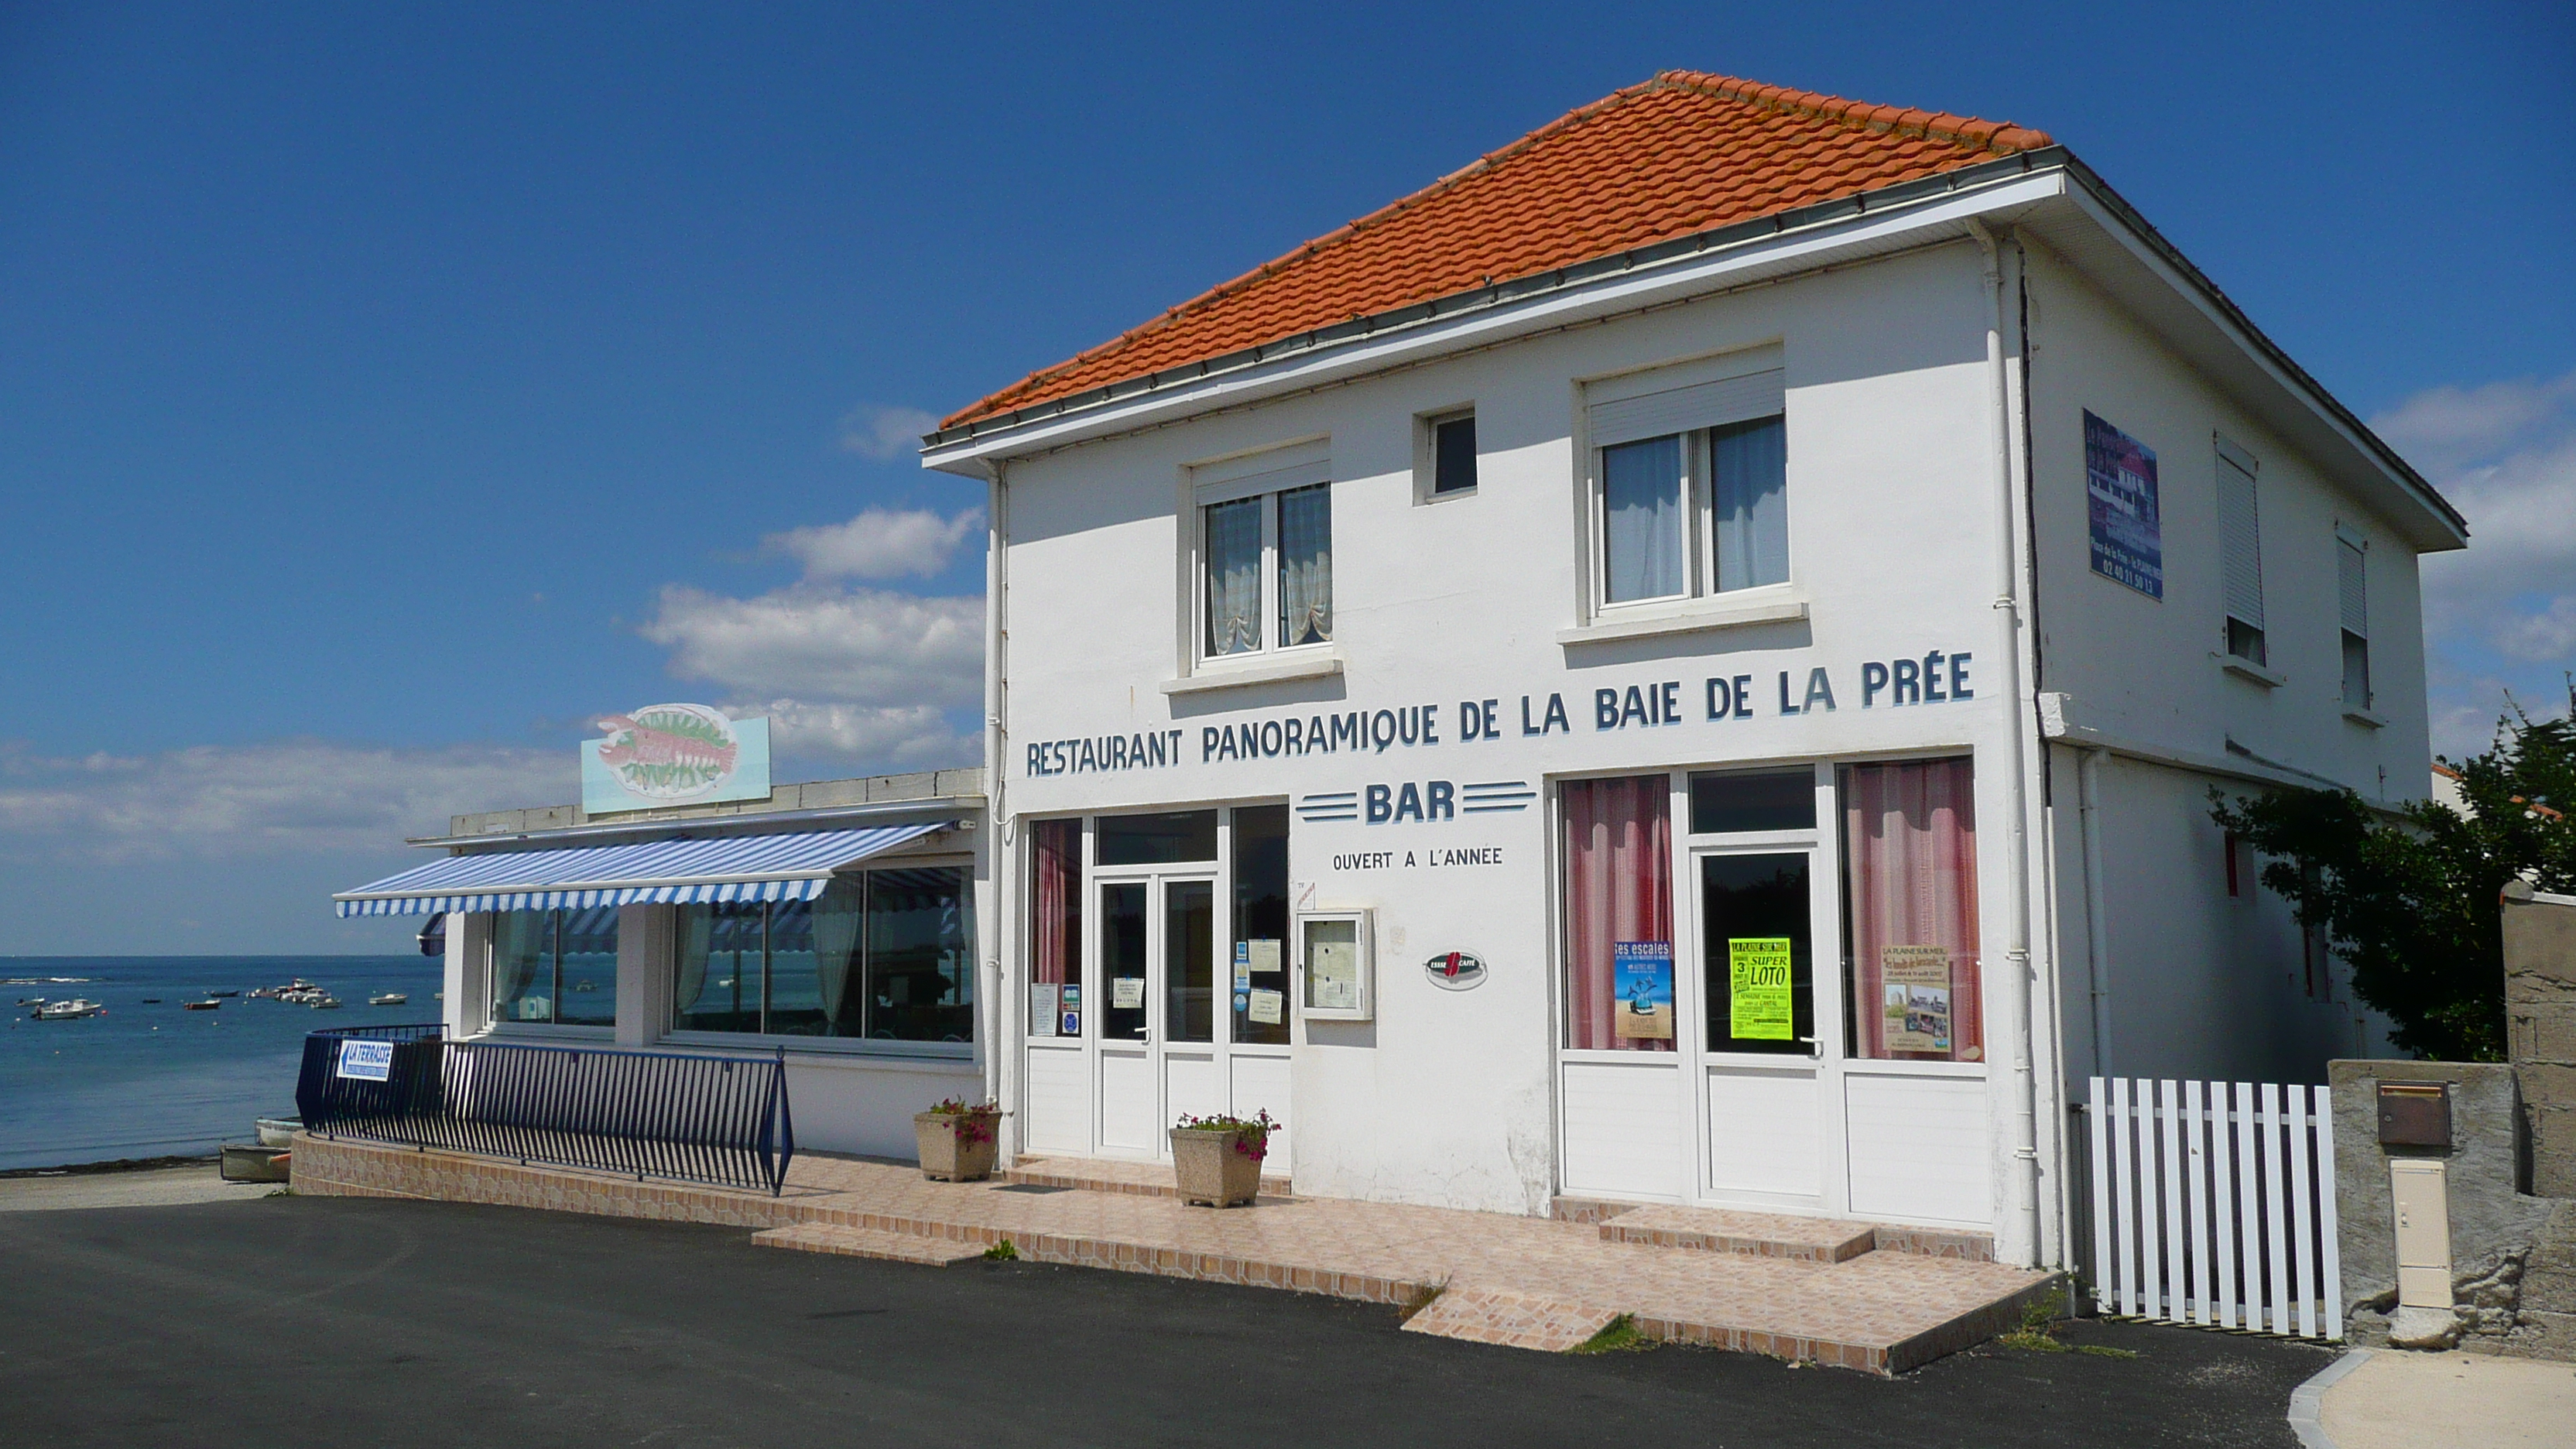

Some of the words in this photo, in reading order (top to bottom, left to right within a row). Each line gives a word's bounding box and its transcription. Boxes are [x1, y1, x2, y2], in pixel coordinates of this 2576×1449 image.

[2103, 559, 2113, 574] 02
[2114, 564, 2123, 581] 40
[2125, 569, 2133, 584] 21
[1027, 729, 1183, 777] RESTAURANT
[1202, 704, 1439, 764] PANORAMIQUE
[1460, 698, 1500, 743] DE
[1522, 692, 1571, 737] LA
[1595, 681, 1681, 732] BAIE
[1706, 674, 1753, 723] DE
[1779, 666, 1837, 717] LA
[1862, 649, 1975, 709] PRÉE
[1365, 780, 1454, 826] BAR
[1333, 852, 1392, 871] OUVERT
[1404, 850, 1416, 868] A
[1430, 844, 1503, 867] L'ANNÉE
[1632, 943, 1669, 954] escales
[1737, 962, 1745, 973] 3
[1750, 956, 1787, 966] SUPER
[1750, 966, 1786, 985] LOTO
[349, 1043, 358, 1060] LA
[358, 1045, 391, 1064] TERRASSE
